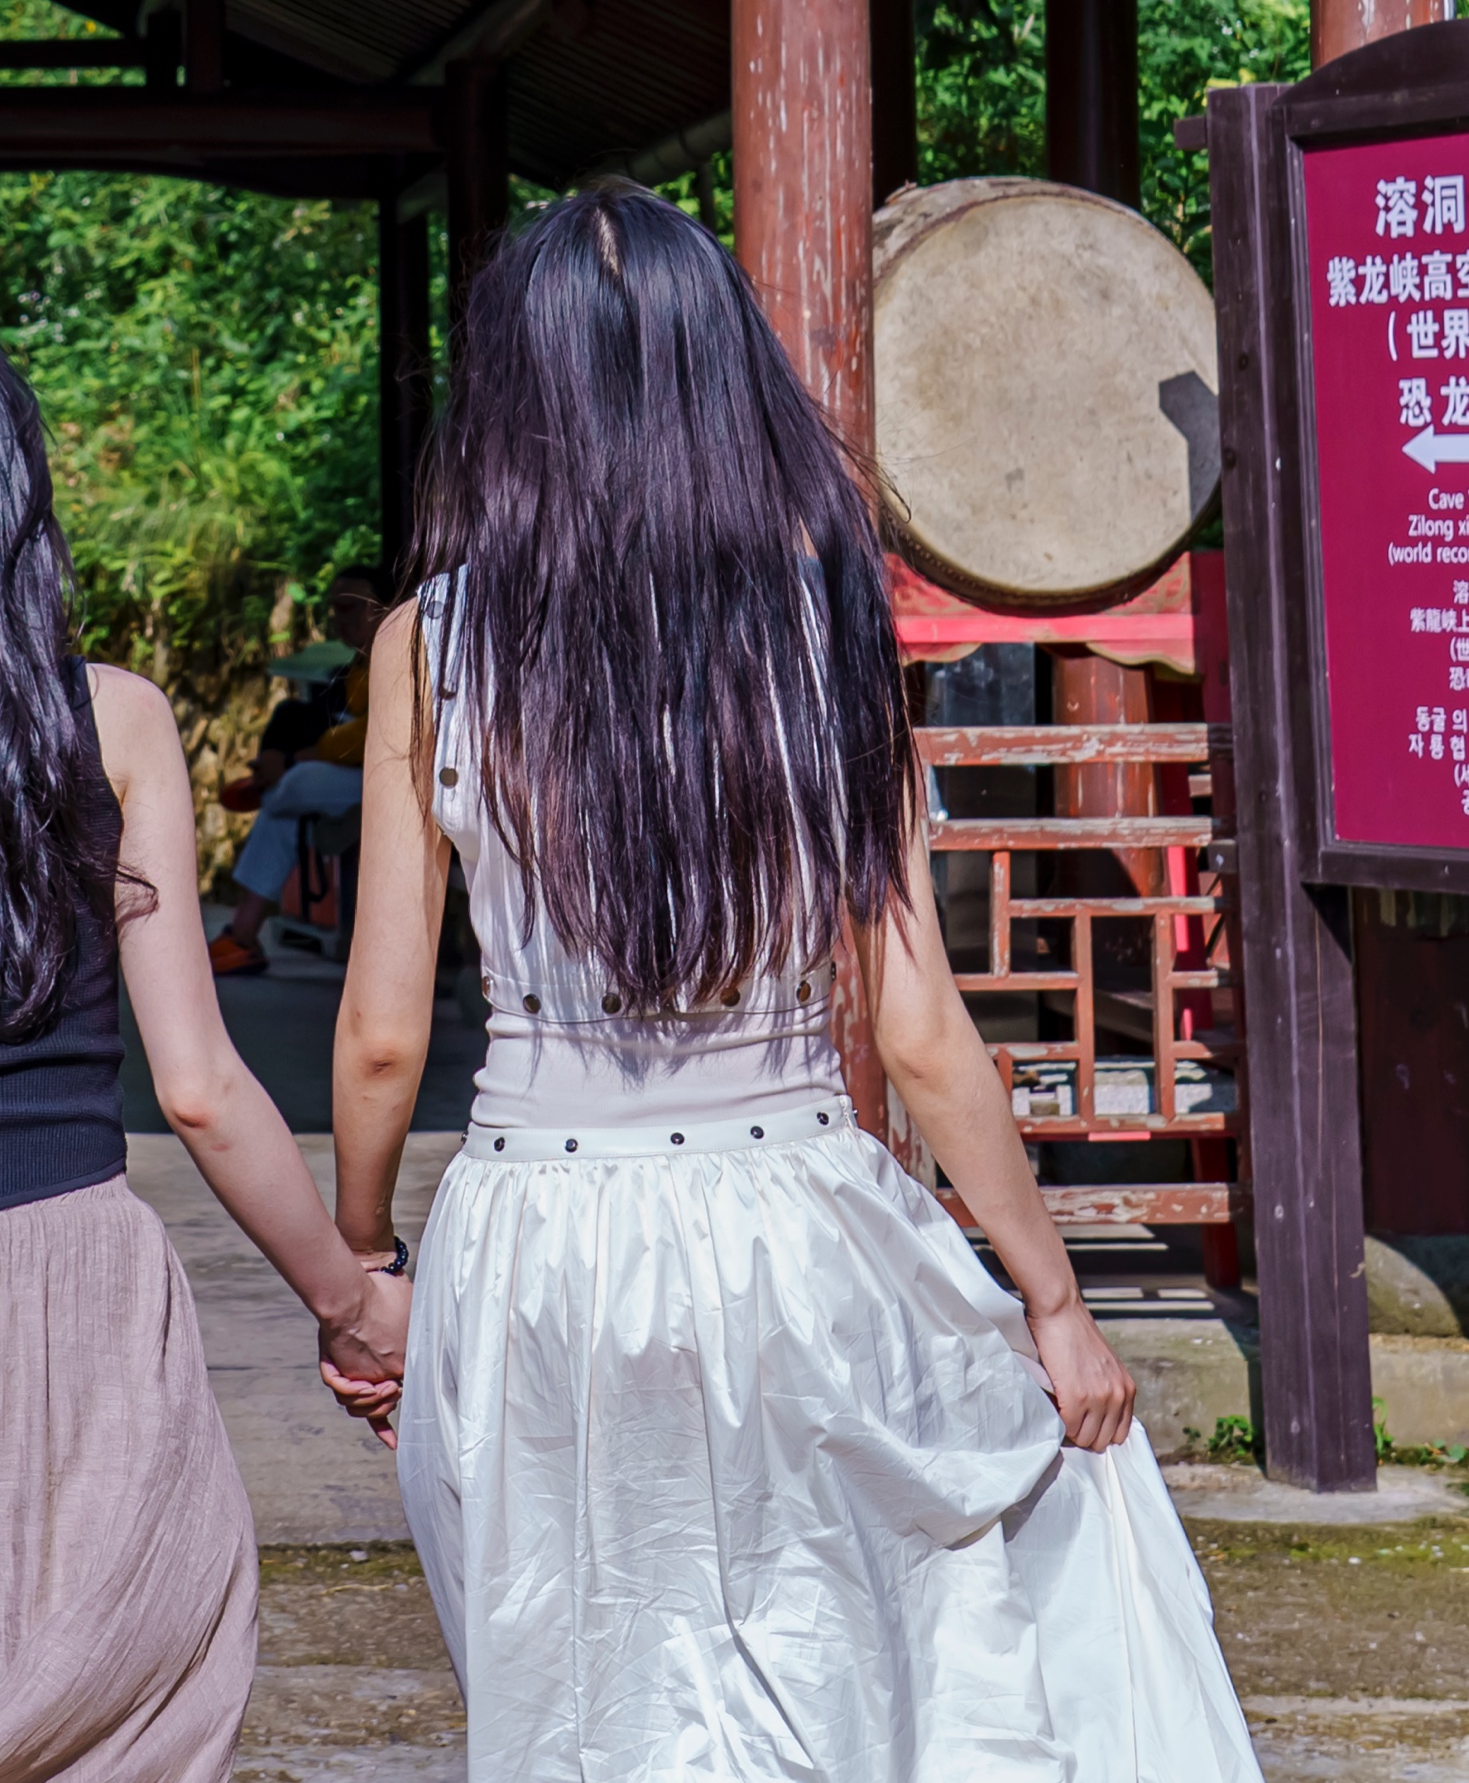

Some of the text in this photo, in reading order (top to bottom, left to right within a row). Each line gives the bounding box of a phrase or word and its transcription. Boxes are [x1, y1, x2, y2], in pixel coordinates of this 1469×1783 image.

[1375, 175, 1466, 238] 溶洞
[1398, 375, 1469, 427] 恐龙
[1428, 487, 1465, 510] Cave
[1408, 514, 1454, 542] Zilong
[1388, 541, 1432, 566] (world
[1415, 706, 1447, 733] 동굴
